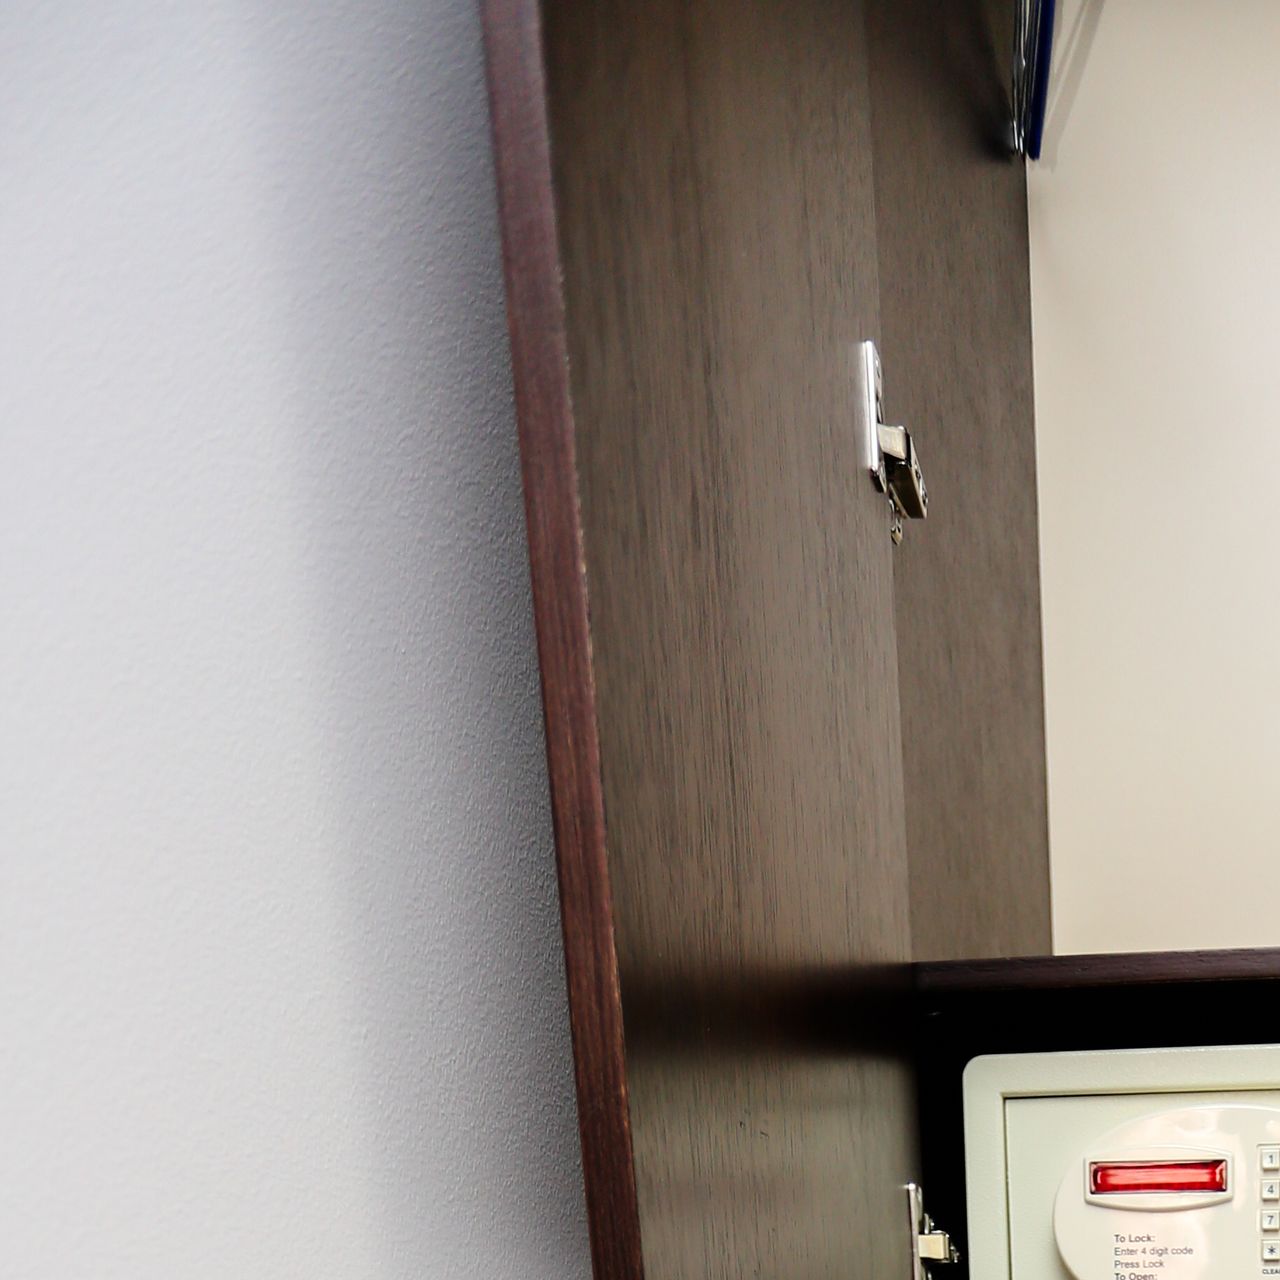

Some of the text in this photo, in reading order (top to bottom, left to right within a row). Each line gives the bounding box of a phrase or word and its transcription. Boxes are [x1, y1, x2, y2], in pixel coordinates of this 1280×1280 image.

[1114, 1233, 1155, 1243] To Lock:
[1114, 1247, 1138, 1256] Enter
[1149, 1247, 1169, 1257] digit
[1171, 1246, 1194, 1255] code
[1114, 1259, 1165, 1269] Press Lock
